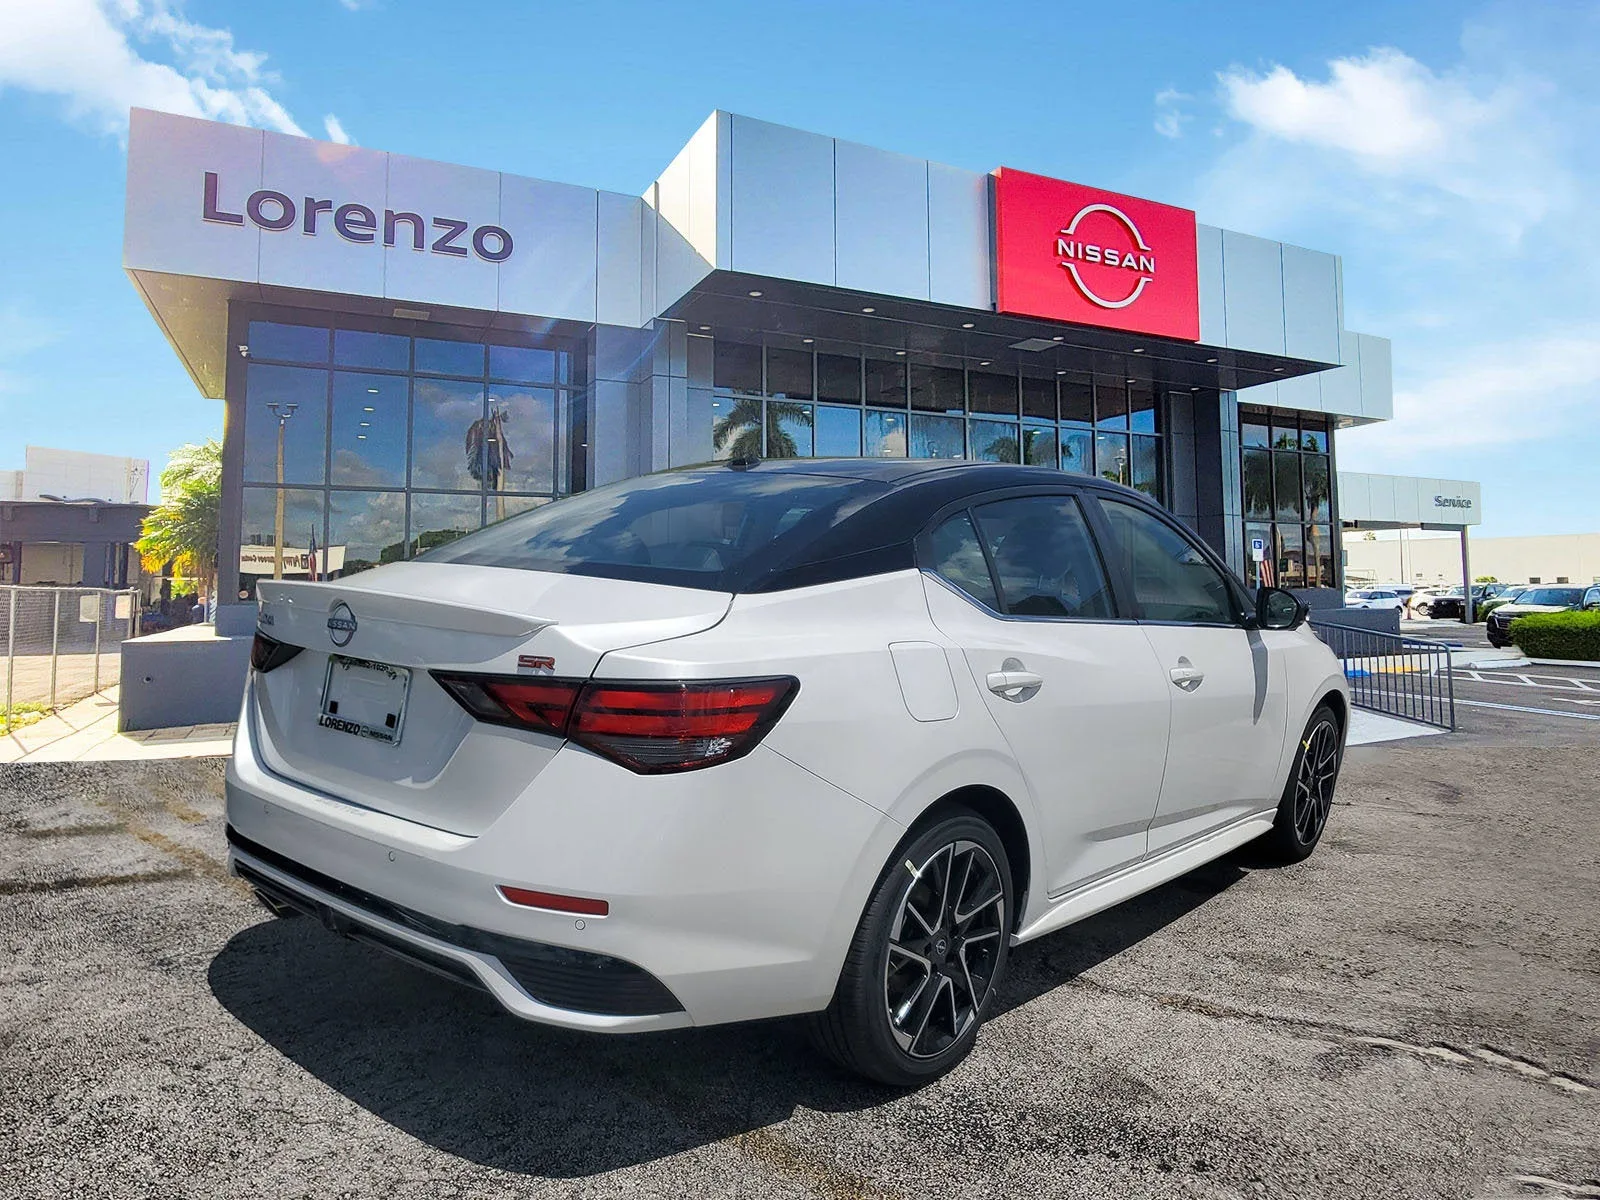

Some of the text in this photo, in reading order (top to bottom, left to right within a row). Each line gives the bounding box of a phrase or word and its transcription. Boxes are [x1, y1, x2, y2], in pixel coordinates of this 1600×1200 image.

[202, 171, 514, 262] Lorenzo
[1057, 238, 1155, 273] NISSAN
[1434, 495, 1472, 509] Service
[518, 654, 556, 671] SR
[318, 714, 361, 736] LORENZO
